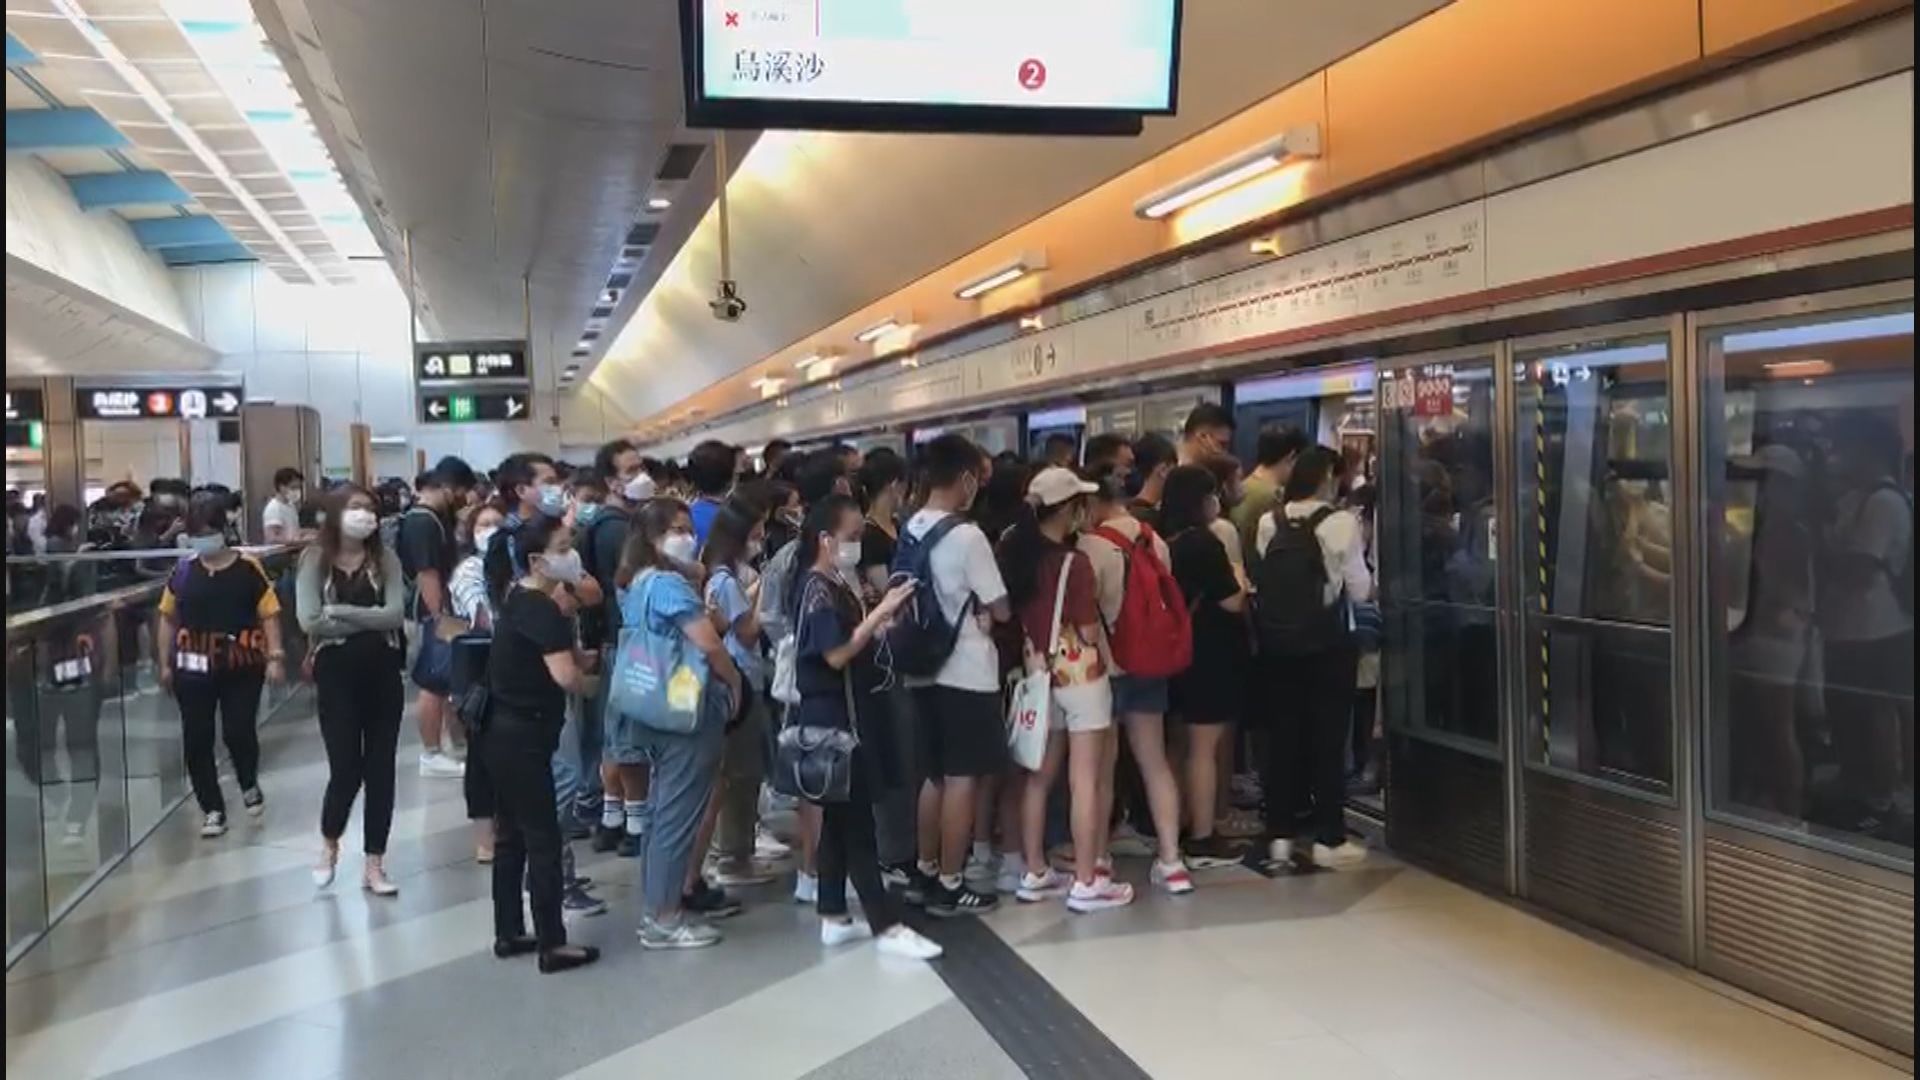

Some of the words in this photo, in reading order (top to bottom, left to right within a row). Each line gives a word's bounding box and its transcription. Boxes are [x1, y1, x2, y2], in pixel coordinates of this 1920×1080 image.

[732, 49, 825, 83] 烏溪沙
[1024, 61, 1041, 87] 2
